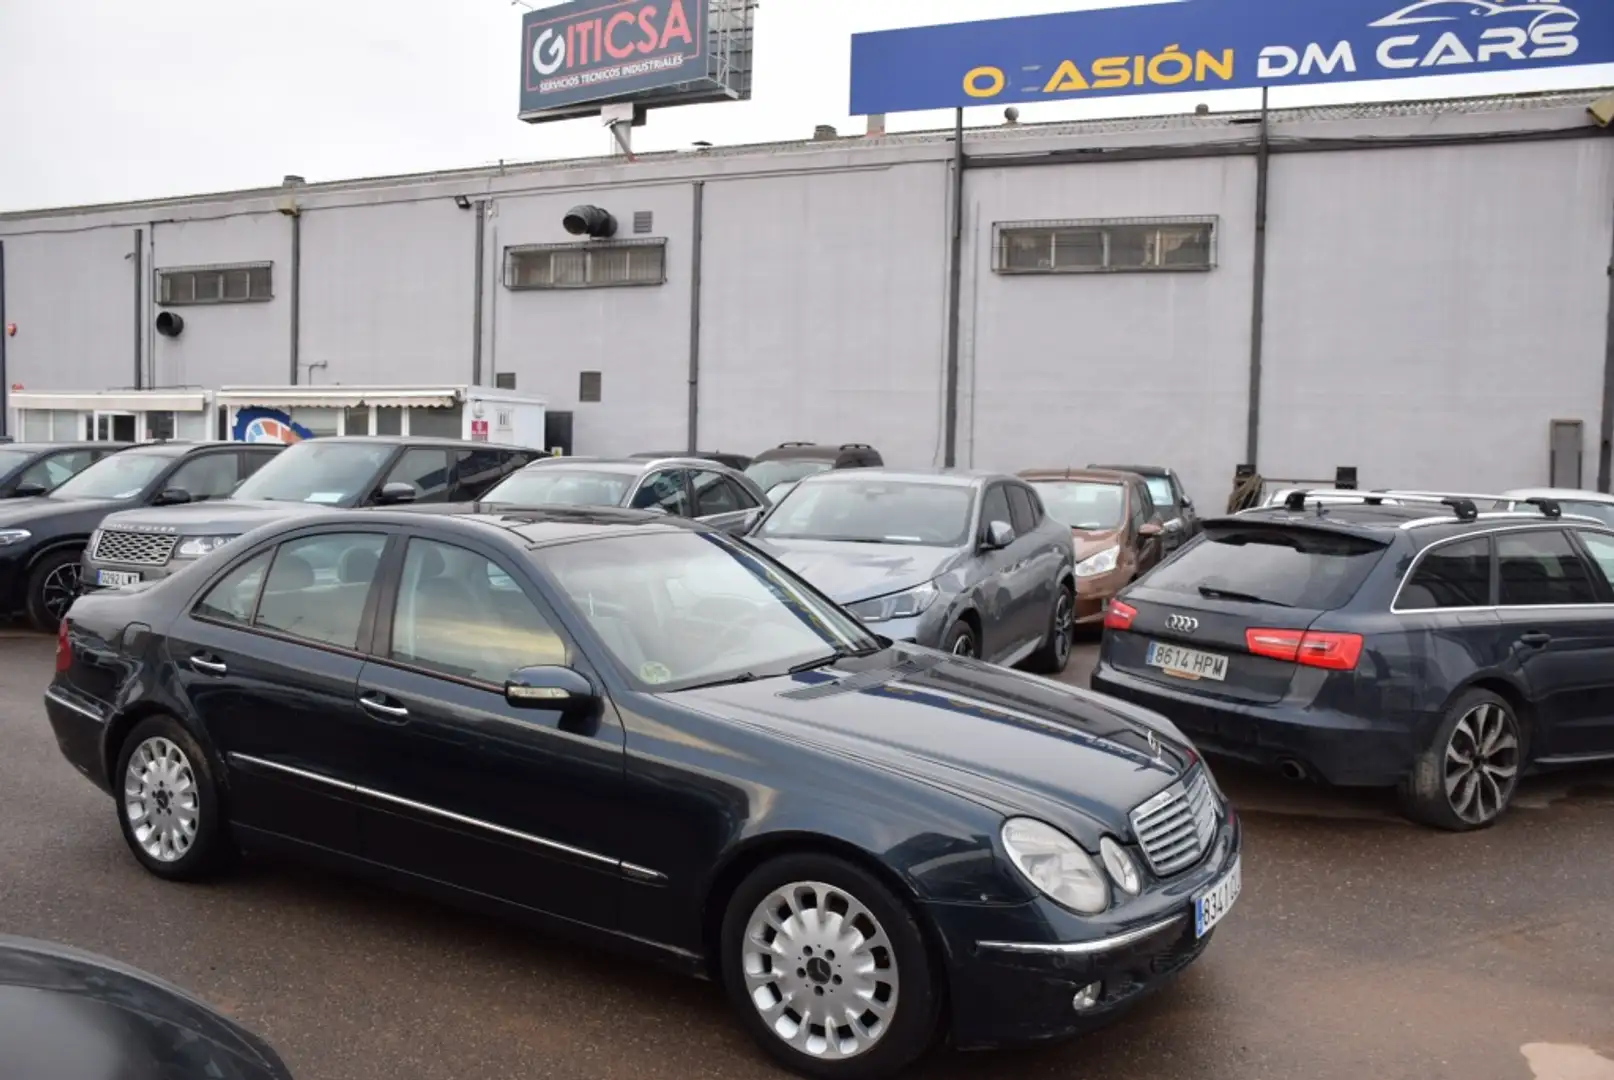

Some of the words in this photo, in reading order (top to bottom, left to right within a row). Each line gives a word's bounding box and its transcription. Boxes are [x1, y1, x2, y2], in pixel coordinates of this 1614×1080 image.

[539, 75, 580, 94] SERVICIOS
[622, 54, 684, 76] INDUSTRIALES
[962, 44, 1234, 98] OASIÓN
[1257, 40, 1357, 78] DM
[1376, 22, 1580, 69] CARS
[1155, 646, 1189, 669] 8614
[1193, 654, 1224, 677] HPM
